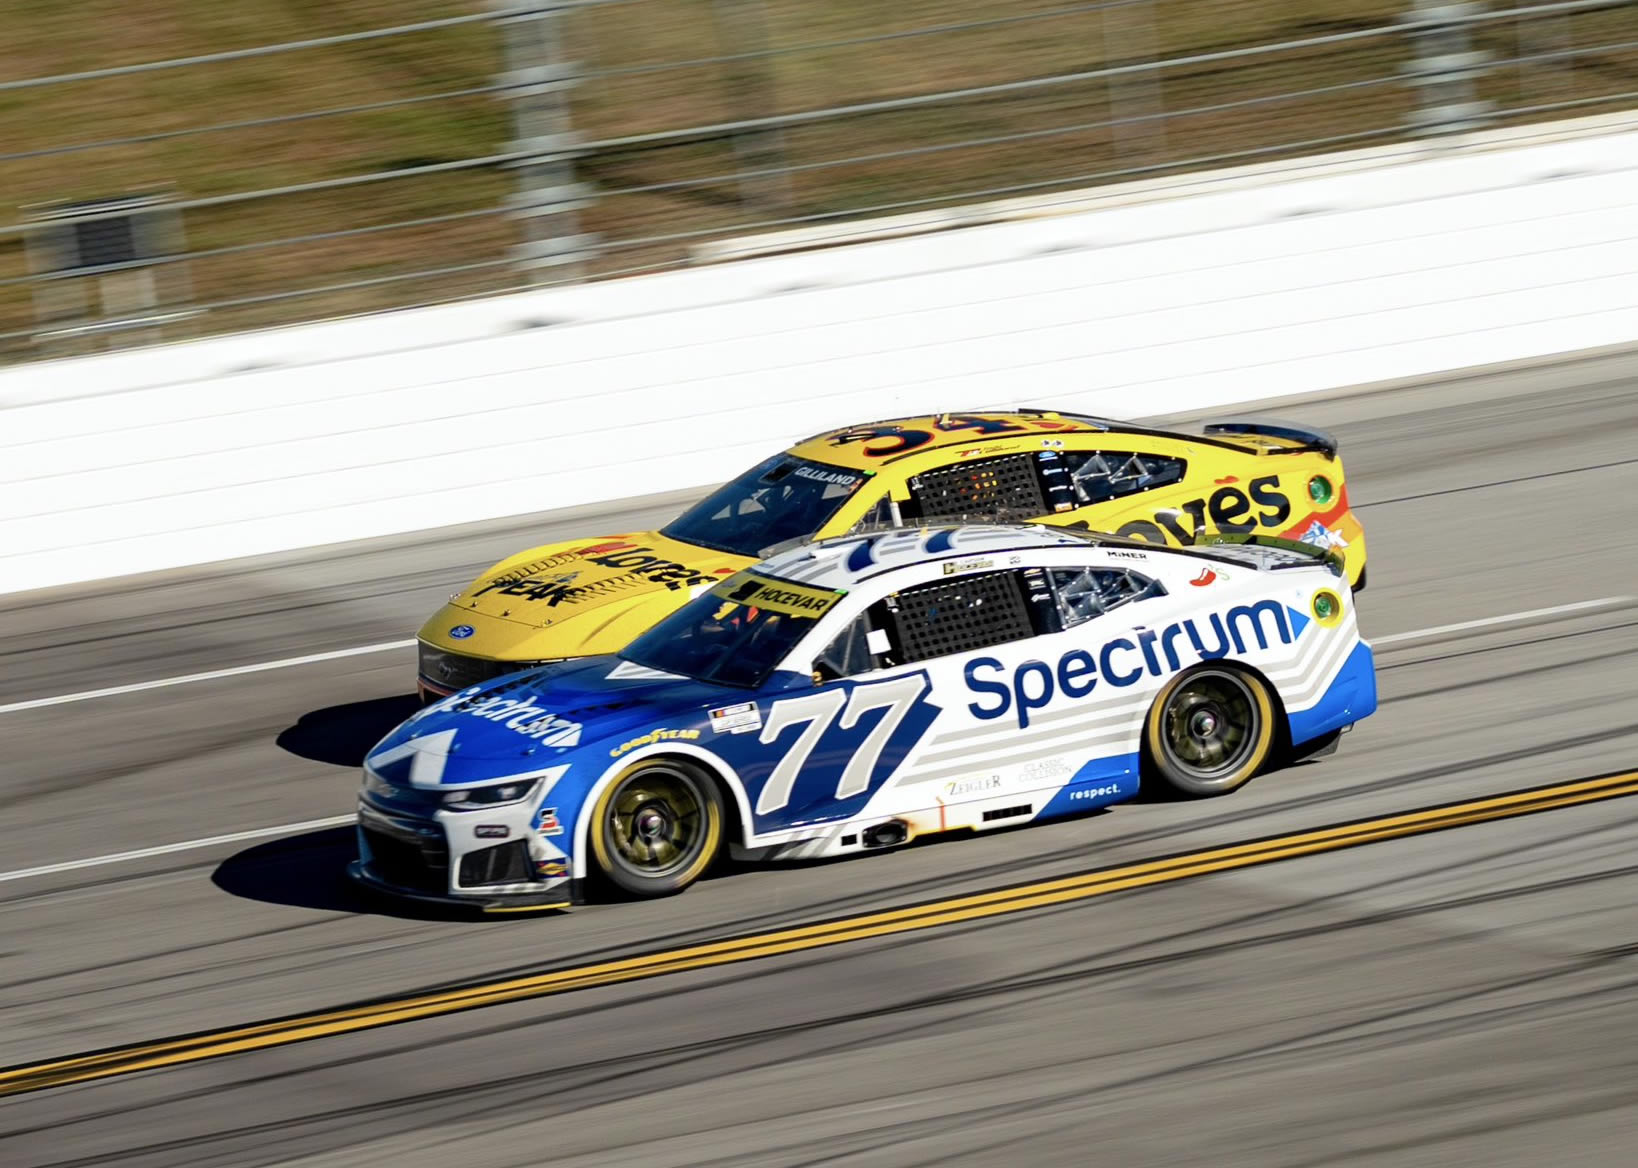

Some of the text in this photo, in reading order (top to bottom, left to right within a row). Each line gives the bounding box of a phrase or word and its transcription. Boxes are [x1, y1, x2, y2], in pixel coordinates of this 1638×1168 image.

[794, 466, 857, 486] GILLILAND
[1061, 474, 1291, 547] oves
[754, 587, 830, 611] HOCEVAR
[963, 599, 1293, 730] Spectrum
[609, 727, 701, 758] GOODYEAR
[755, 672, 928, 817] 77
[949, 775, 1001, 796] ZEIGLER
[1069, 783, 1121, 800] respect.
